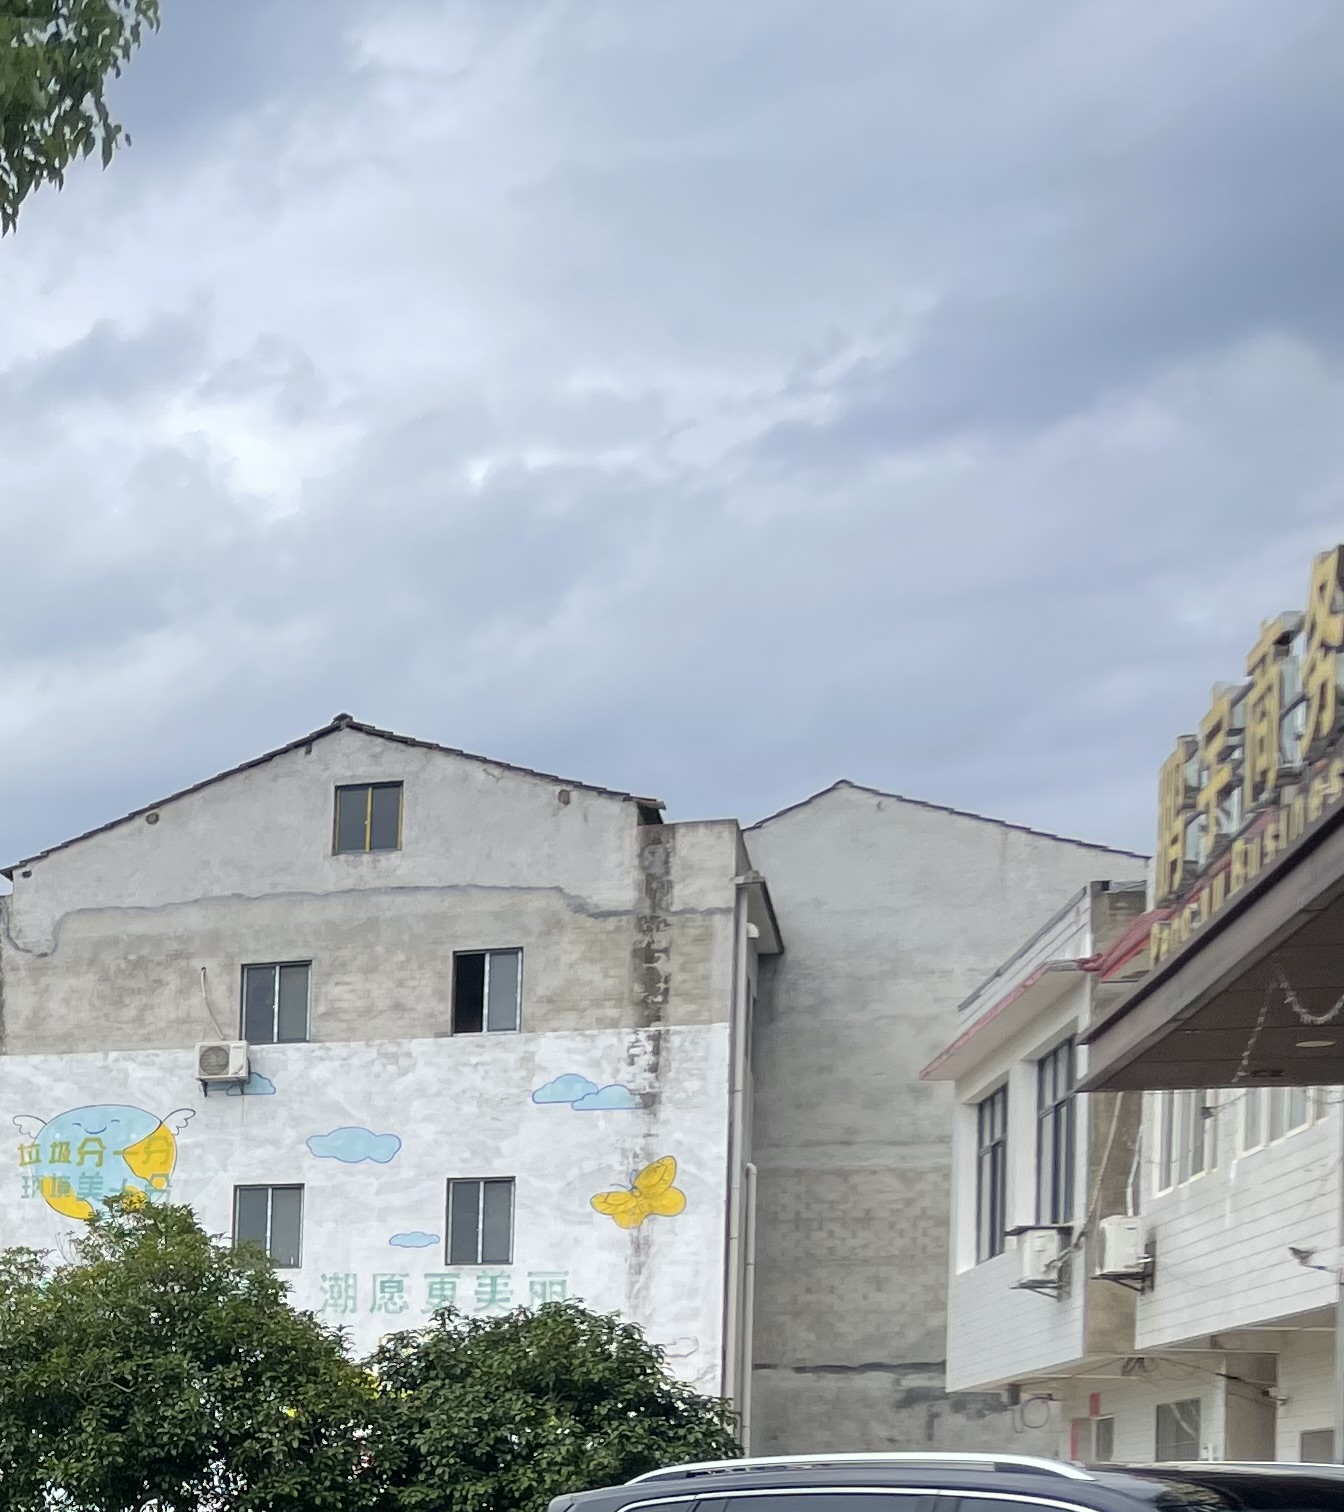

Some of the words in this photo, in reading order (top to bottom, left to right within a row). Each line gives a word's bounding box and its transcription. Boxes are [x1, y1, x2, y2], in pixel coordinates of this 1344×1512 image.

[17, 1135, 173, 1167] 垃圾分一分
